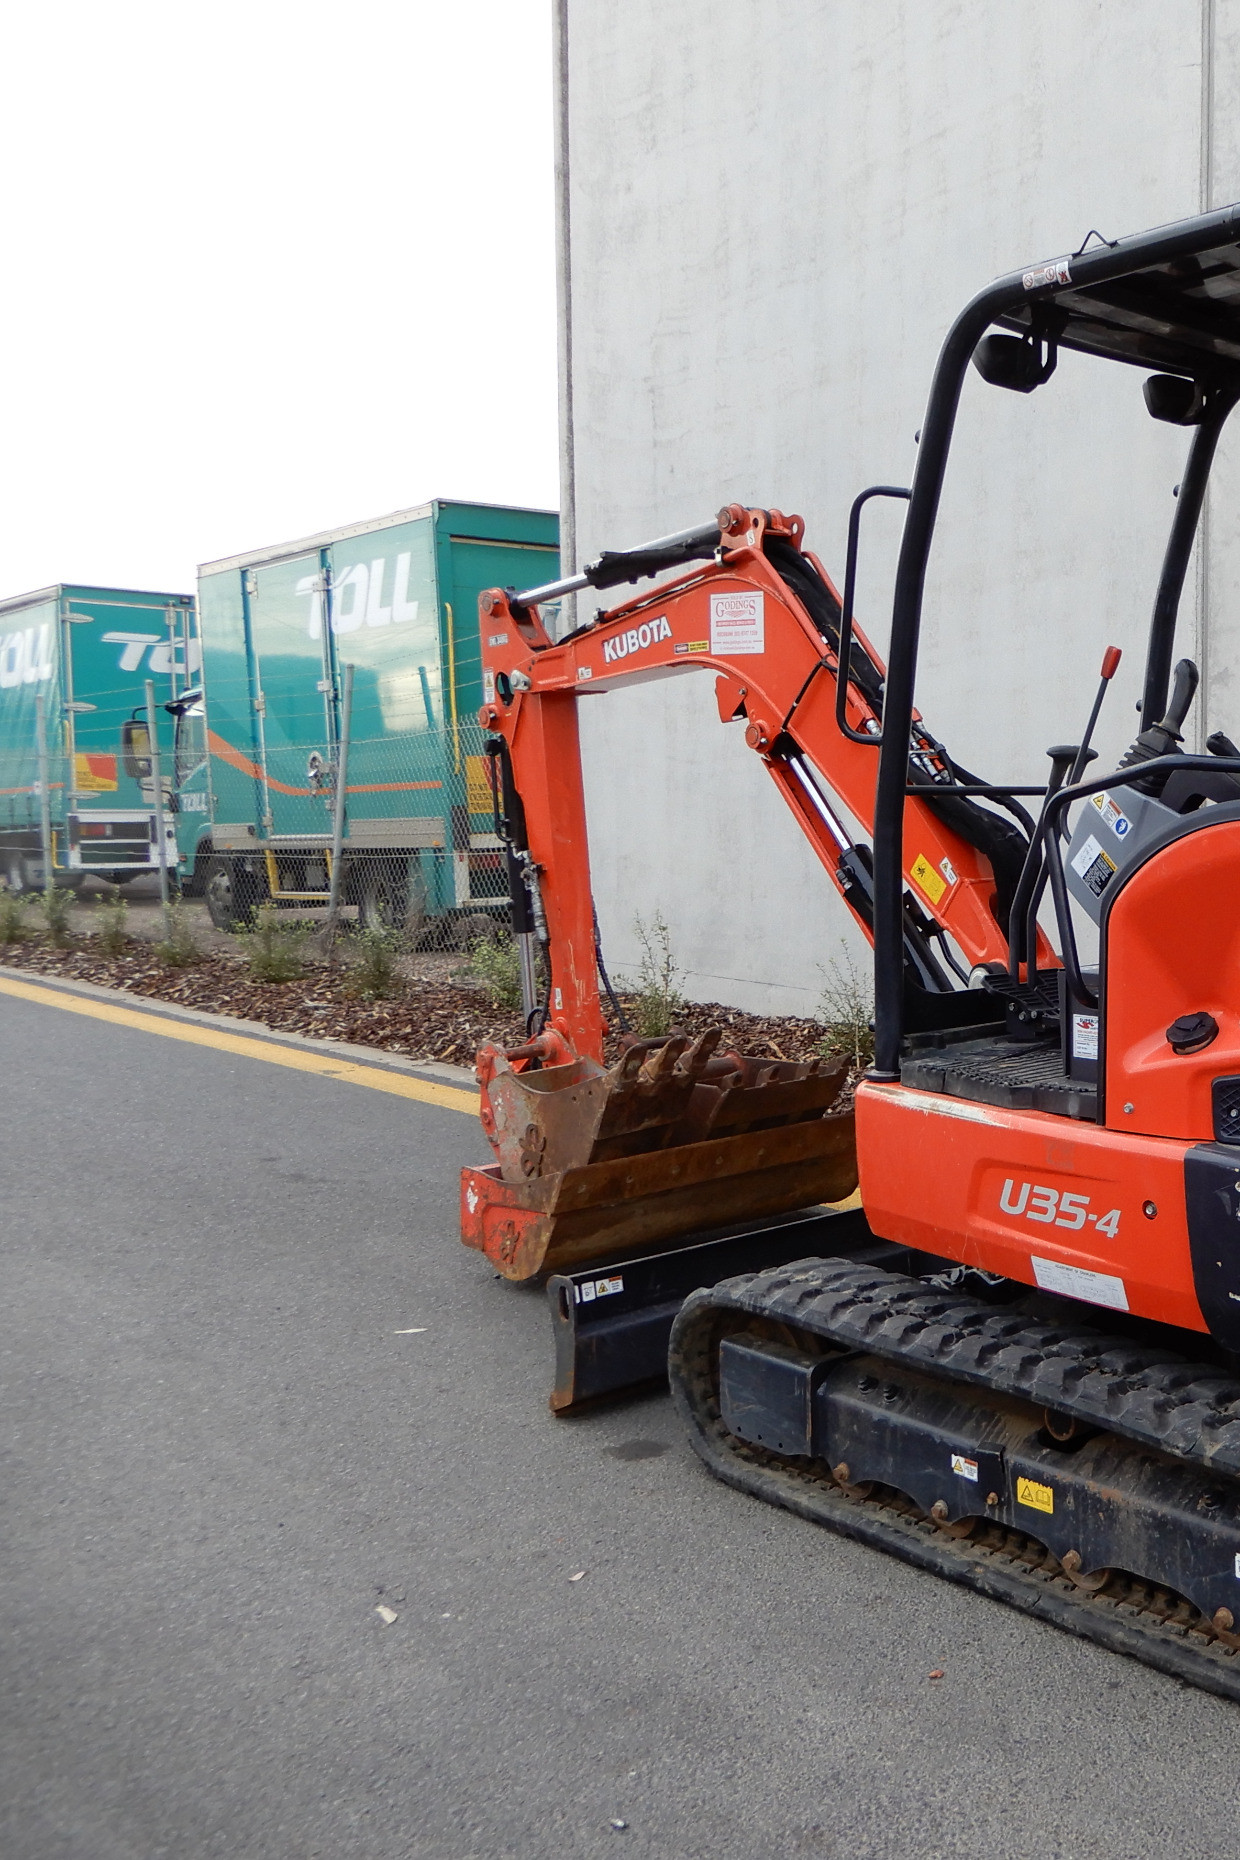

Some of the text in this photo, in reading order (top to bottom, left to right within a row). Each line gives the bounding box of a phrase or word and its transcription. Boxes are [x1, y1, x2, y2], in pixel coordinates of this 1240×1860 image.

[295, 552, 419, 640] TOLL
[0, 623, 52, 689] OLL
[101, 631, 200, 675] TO
[602, 614, 673, 664] KUBOTA
[999, 1178, 1122, 1239] U35-4
